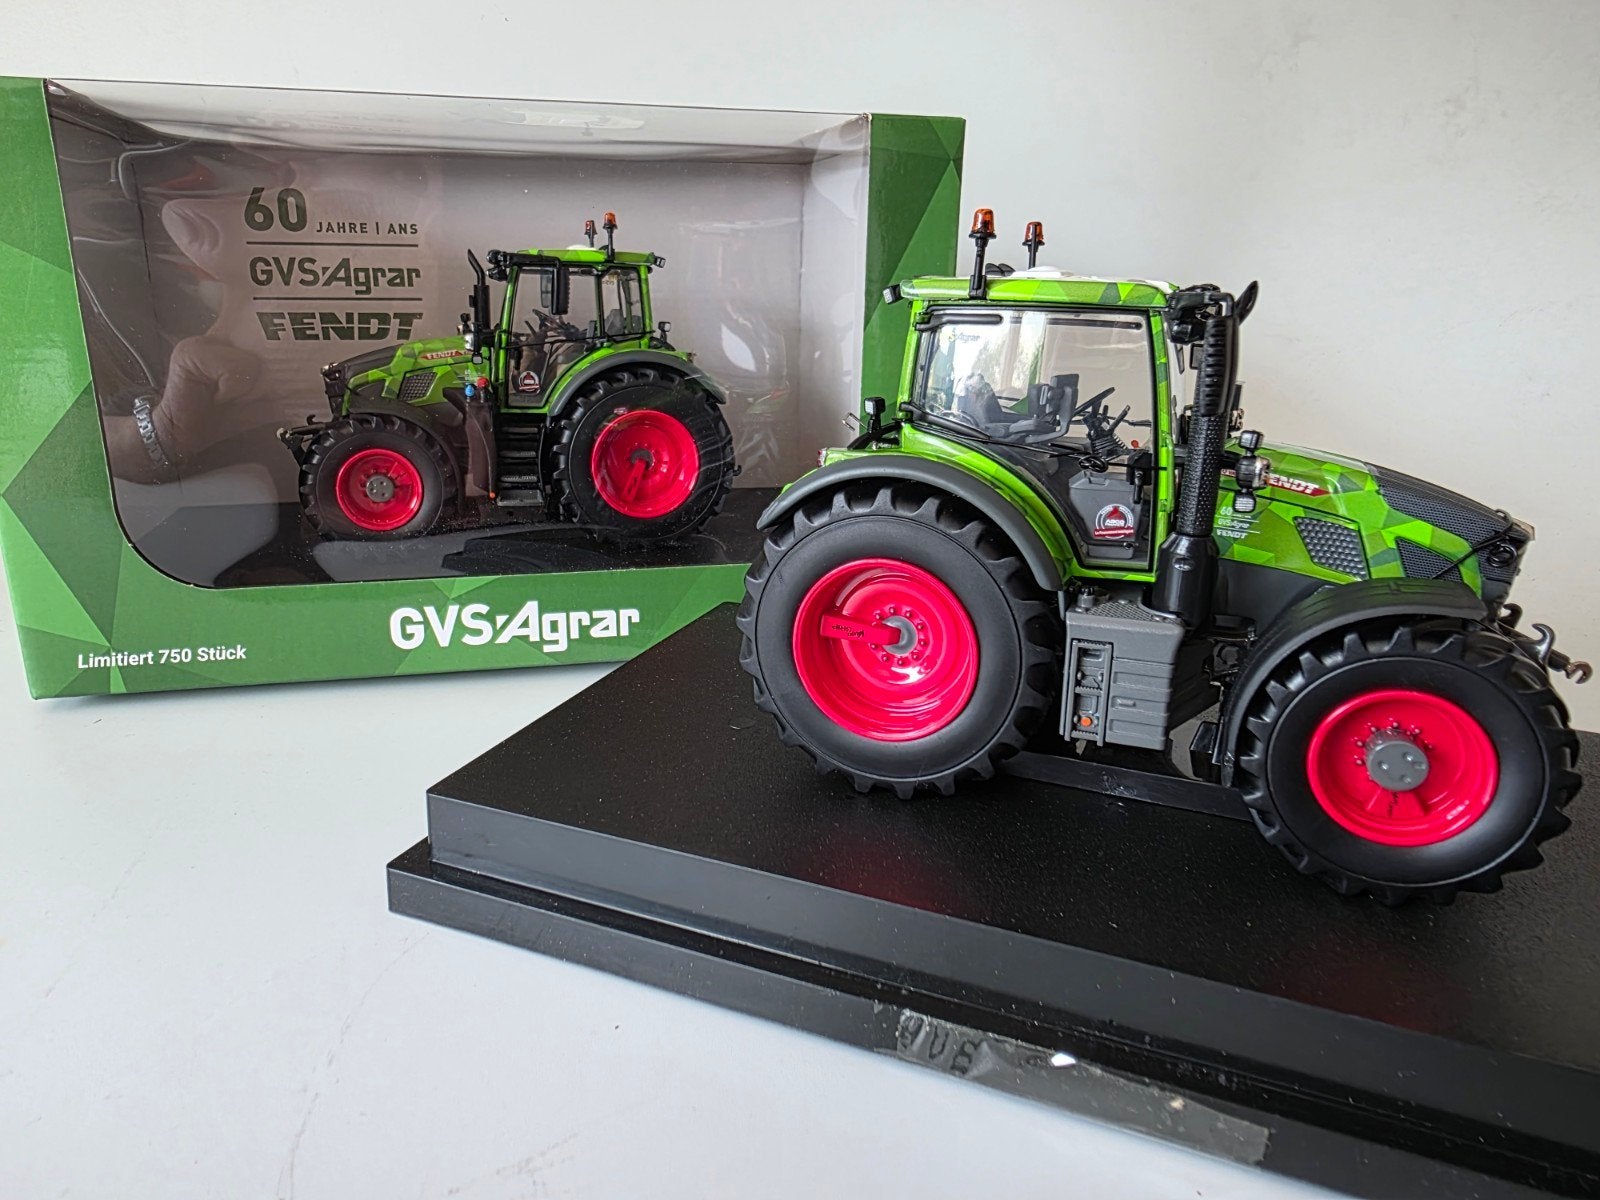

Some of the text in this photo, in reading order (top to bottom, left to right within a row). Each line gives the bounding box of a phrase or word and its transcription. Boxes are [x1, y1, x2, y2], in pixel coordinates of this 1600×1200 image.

[244, 187, 307, 232] 60
[316, 222, 368, 234] JAHRE
[387, 223, 418, 234] ANS
[256, 312, 423, 341] FENDT
[426, 350, 457, 360] FENDT
[1268, 473, 1320, 494] ENDT
[1217, 529, 1248, 539] FENDT
[78, 645, 247, 668] Limitiert 750 Stück
